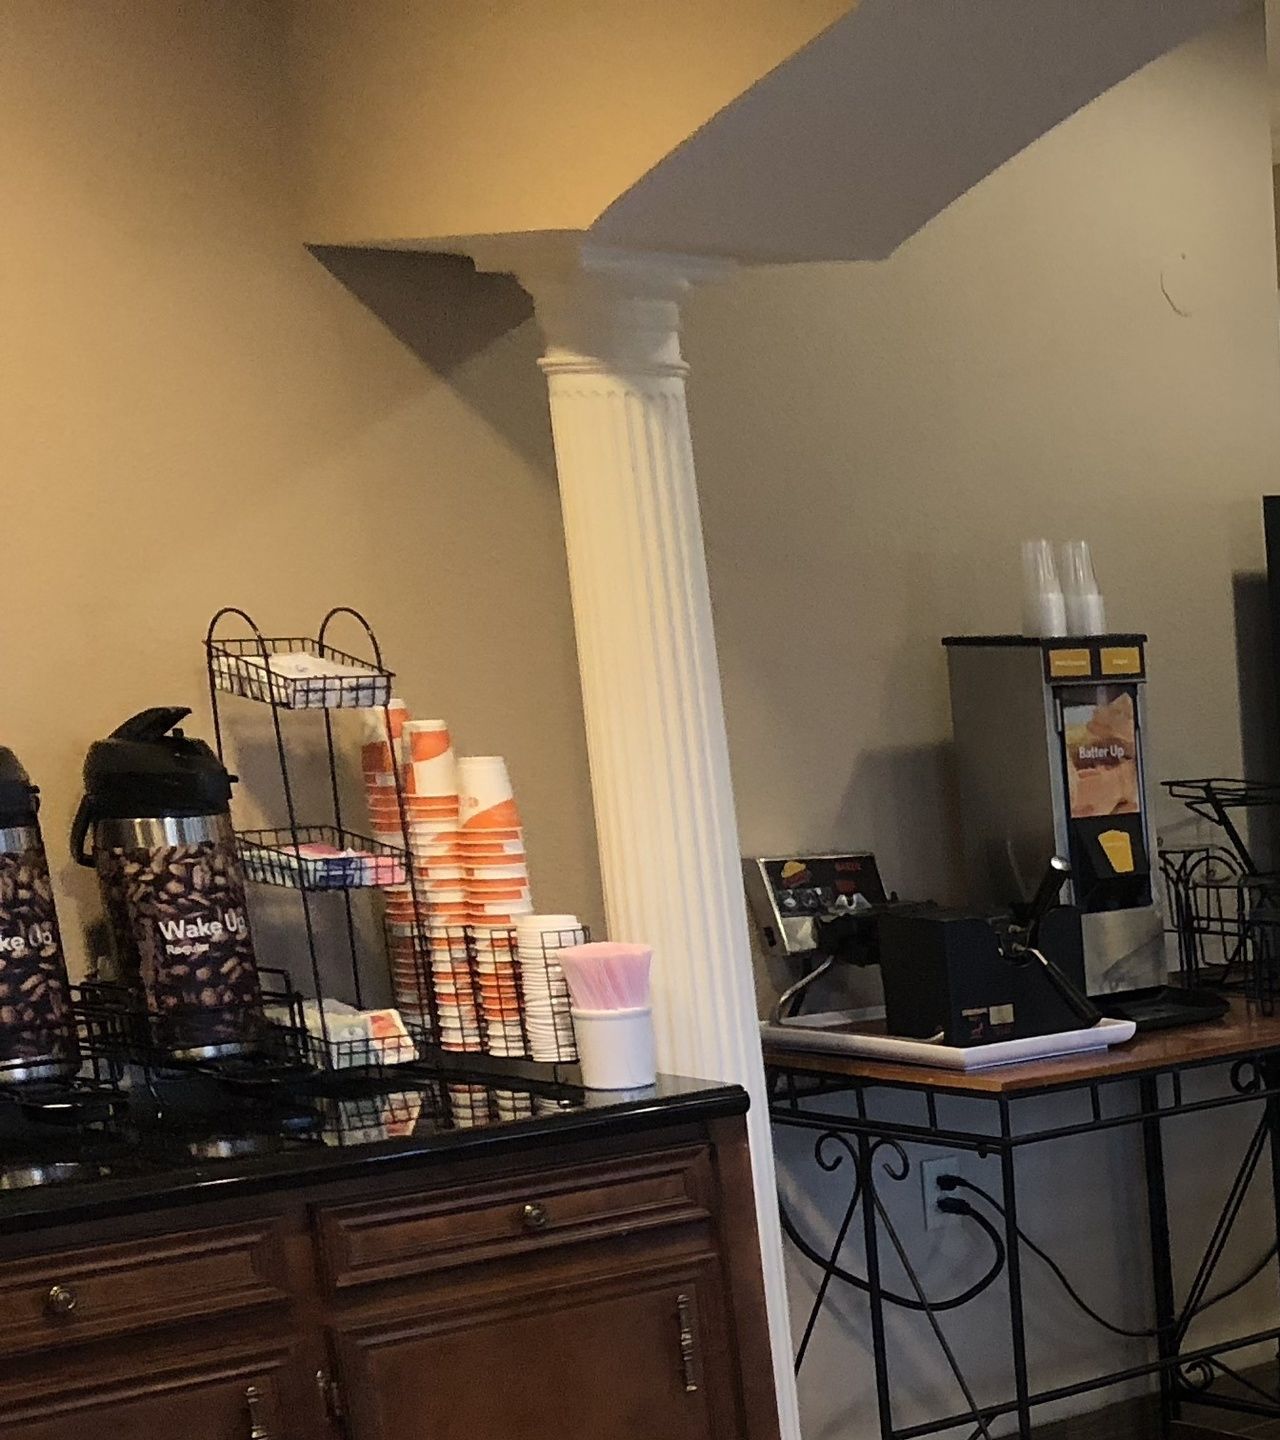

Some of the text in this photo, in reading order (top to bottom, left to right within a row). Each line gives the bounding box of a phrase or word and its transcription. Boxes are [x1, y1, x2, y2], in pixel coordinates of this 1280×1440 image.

[1078, 744, 1125, 759] Batter Up
[157, 907, 246, 941] Wake Up
[0, 934, 25, 952] ke
